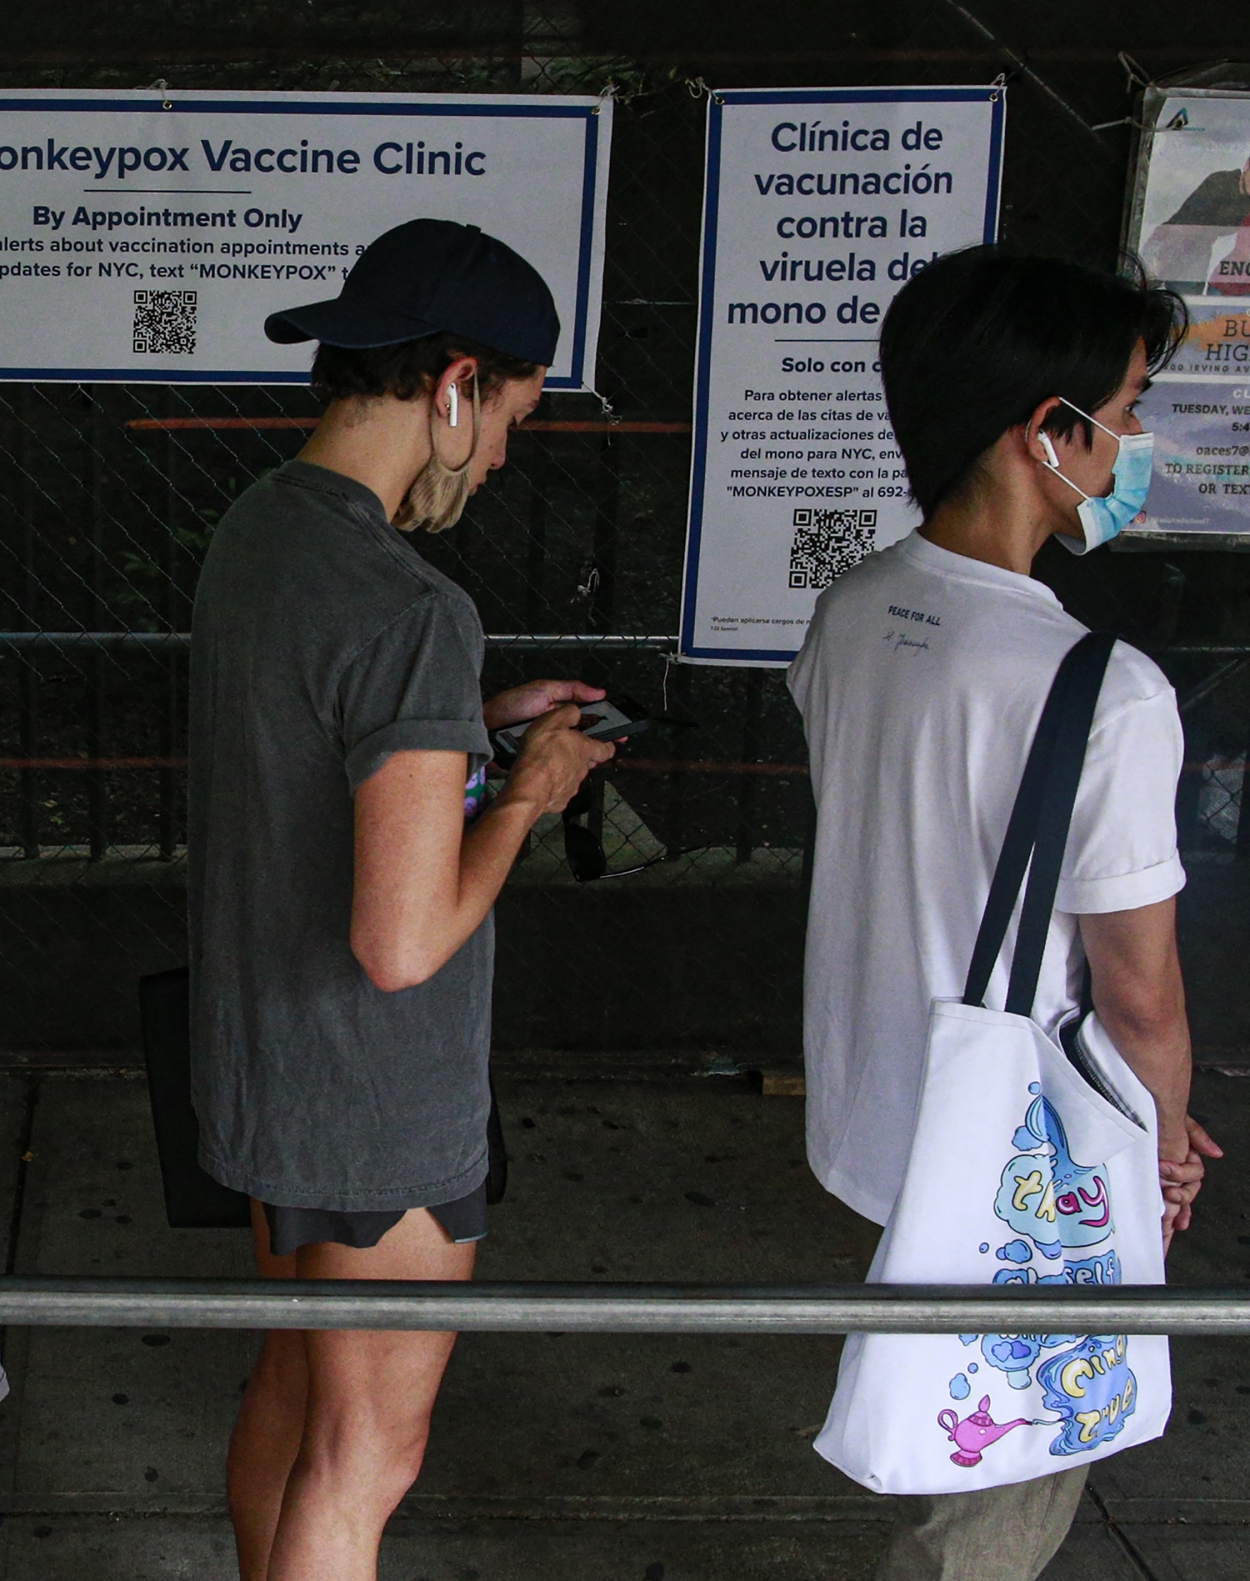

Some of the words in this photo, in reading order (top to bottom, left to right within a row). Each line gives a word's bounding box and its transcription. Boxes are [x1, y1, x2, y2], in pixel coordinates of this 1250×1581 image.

[771, 120, 890, 153] Clínica
[901, 120, 943, 151] de
[200, 139, 361, 174] Vaccine
[373, 140, 487, 176] Clinic
[753, 163, 953, 196] vacunación
[33, 205, 66, 231] By
[71, 205, 237, 231] Appointment
[243, 207, 303, 234] Only
[776, 211, 888, 239] contra
[899, 208, 927, 238] la
[49, 236, 104, 253] about
[108, 237, 214, 254] vaccination
[220, 239, 349, 258] appointments
[66, 261, 93, 277] for
[98, 262, 144, 280] NYC,
[149, 263, 185, 279] text
[189, 263, 336, 281] “MONKEYPOX”
[759, 250, 876, 282] viruela
[727, 302, 827, 325] mono
[836, 294, 881, 325] de
[1223, 319, 1250, 338] BU
[1205, 343, 1250, 362] HIG
[781, 357, 825, 373] Solo
[830, 360, 866, 373] con
[1190, 364, 1229, 373] IRVING
[744, 389, 775, 401] Para
[778, 389, 833, 402] obtener
[835, 389, 882, 402] alertas
[728, 411, 773, 421] acerca
[776, 409, 795, 421] de
[797, 409, 817, 421] las
[820, 408, 853, 421] citas
[855, 409, 874, 421] de
[1171, 403, 1229, 416] TUESDAY,
[720, 431, 729, 443] y
[731, 429, 766, 440] otras
[769, 428, 873, 441] actualizaciones
[740, 447, 762, 460] del
[764, 450, 804, 460] mono
[807, 450, 838, 462] para
[841, 448, 876, 461] NYC,
[1195, 445, 1250, 457] oaces7@
[730, 466, 788, 481] mensaje
[790, 467, 808, 479] de
[811, 467, 846, 479] texto
[848, 469, 874, 479] con
[877, 467, 889, 479] la
[1164, 463, 1183, 474] TO
[1185, 464, 1250, 476] REGISTER
[726, 485, 859, 498] "MONKEYPOXESP"
[862, 486, 874, 498] al
[1198, 483, 1217, 495] OR
[887, 605, 910, 619] PEACE
[910, 611, 925, 622] FOR
[925, 614, 941, 627] ALL
